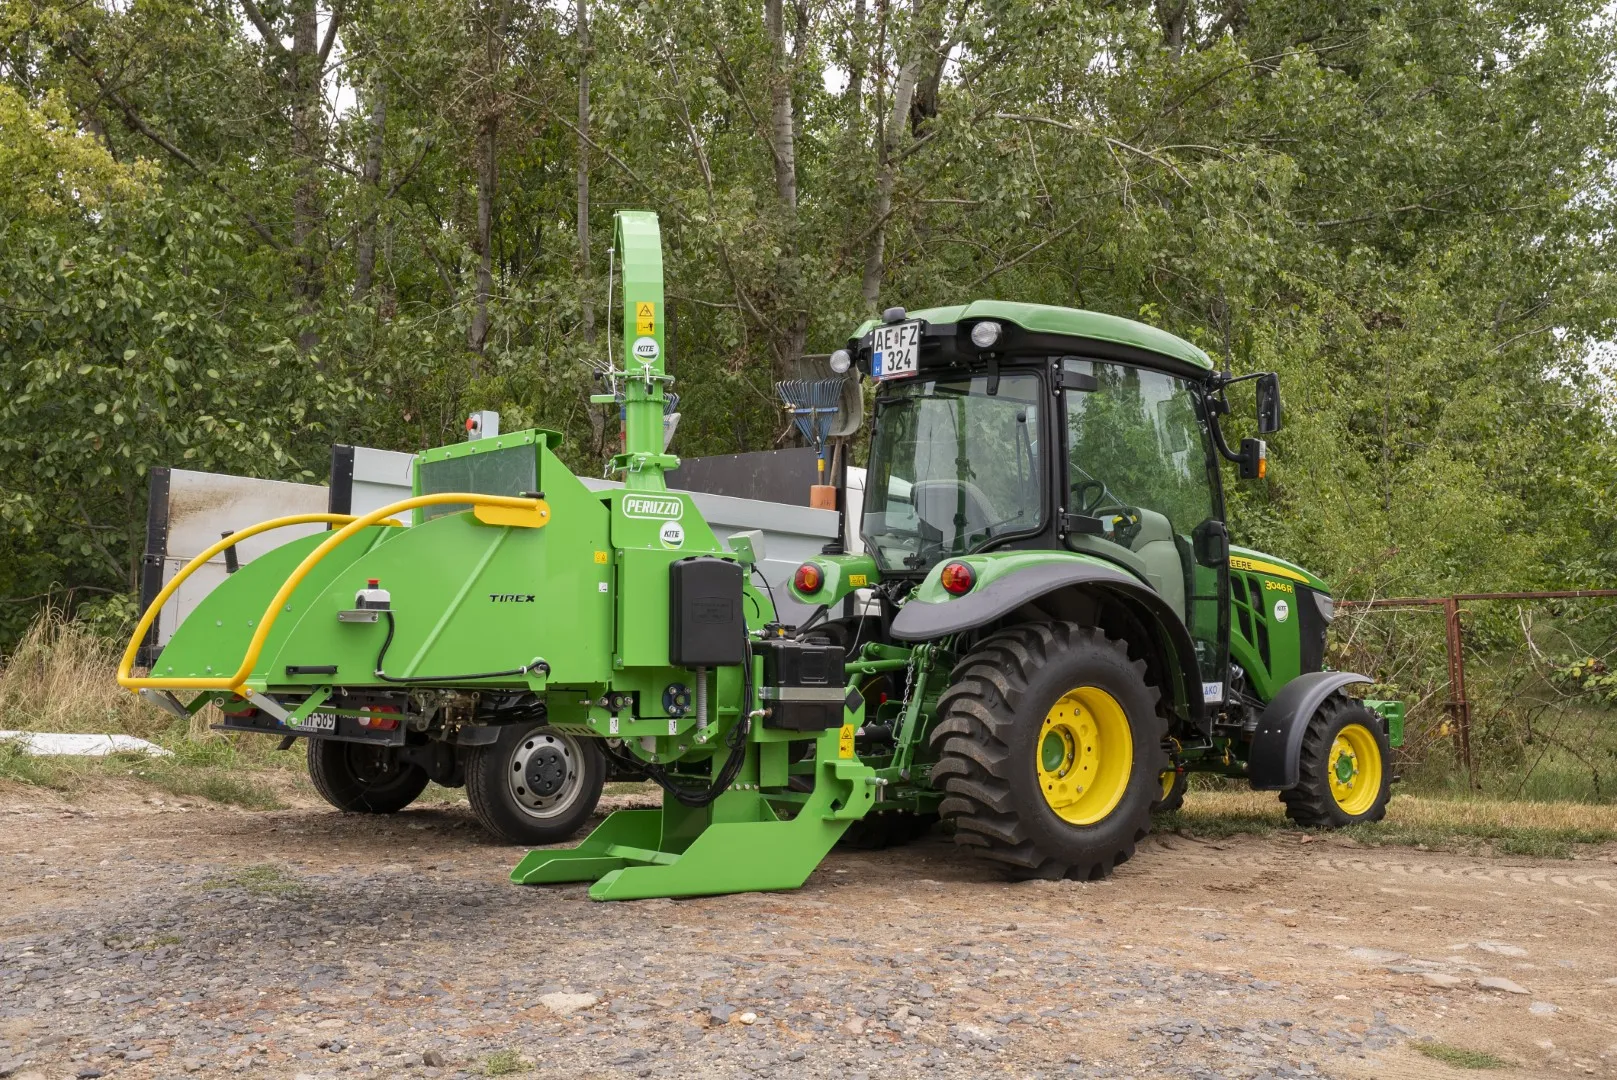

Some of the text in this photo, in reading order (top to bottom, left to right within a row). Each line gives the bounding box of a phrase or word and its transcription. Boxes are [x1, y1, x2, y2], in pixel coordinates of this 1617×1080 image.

[876, 325, 917, 351] AE FZ
[888, 348, 911, 371] 324
[627, 500, 679, 515] PERUZZO
[664, 530, 680, 538] KITE
[1229, 559, 1252, 570] EERE
[490, 594, 536, 602] TIREX
